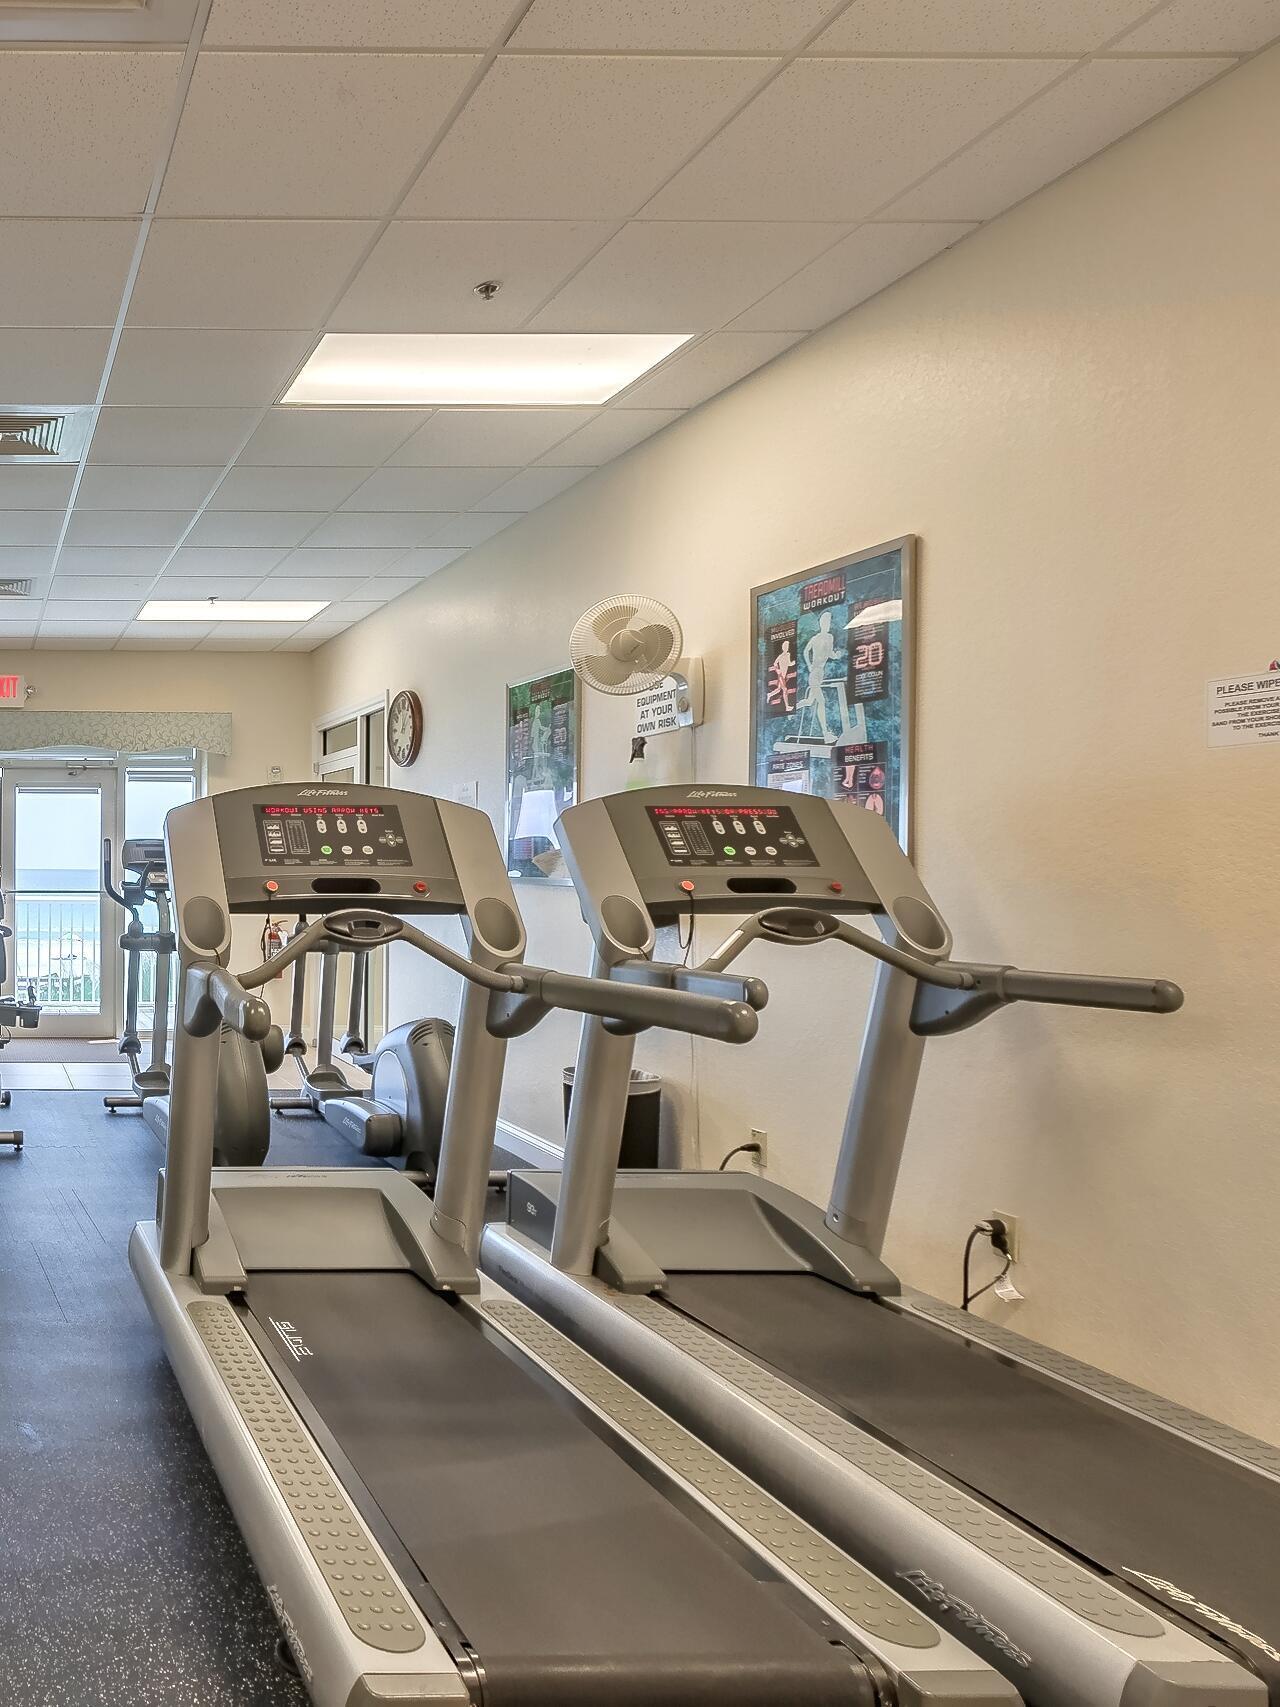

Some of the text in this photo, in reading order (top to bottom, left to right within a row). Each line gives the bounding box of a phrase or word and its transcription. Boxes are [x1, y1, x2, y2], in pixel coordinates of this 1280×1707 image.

[803, 575, 845, 600] TREADMILL
[803, 591, 846, 610] WORKOUT
[853, 641, 883, 669] 20
[1216, 682, 1254, 694] PLEASE
[636, 689, 677, 707] EQUIPMENT
[640, 704, 673, 720] AT YOUR
[637, 716, 677, 733] OWN RISK
[845, 745, 874, 753] HEALTH
[845, 754, 874, 762] BENEFITS
